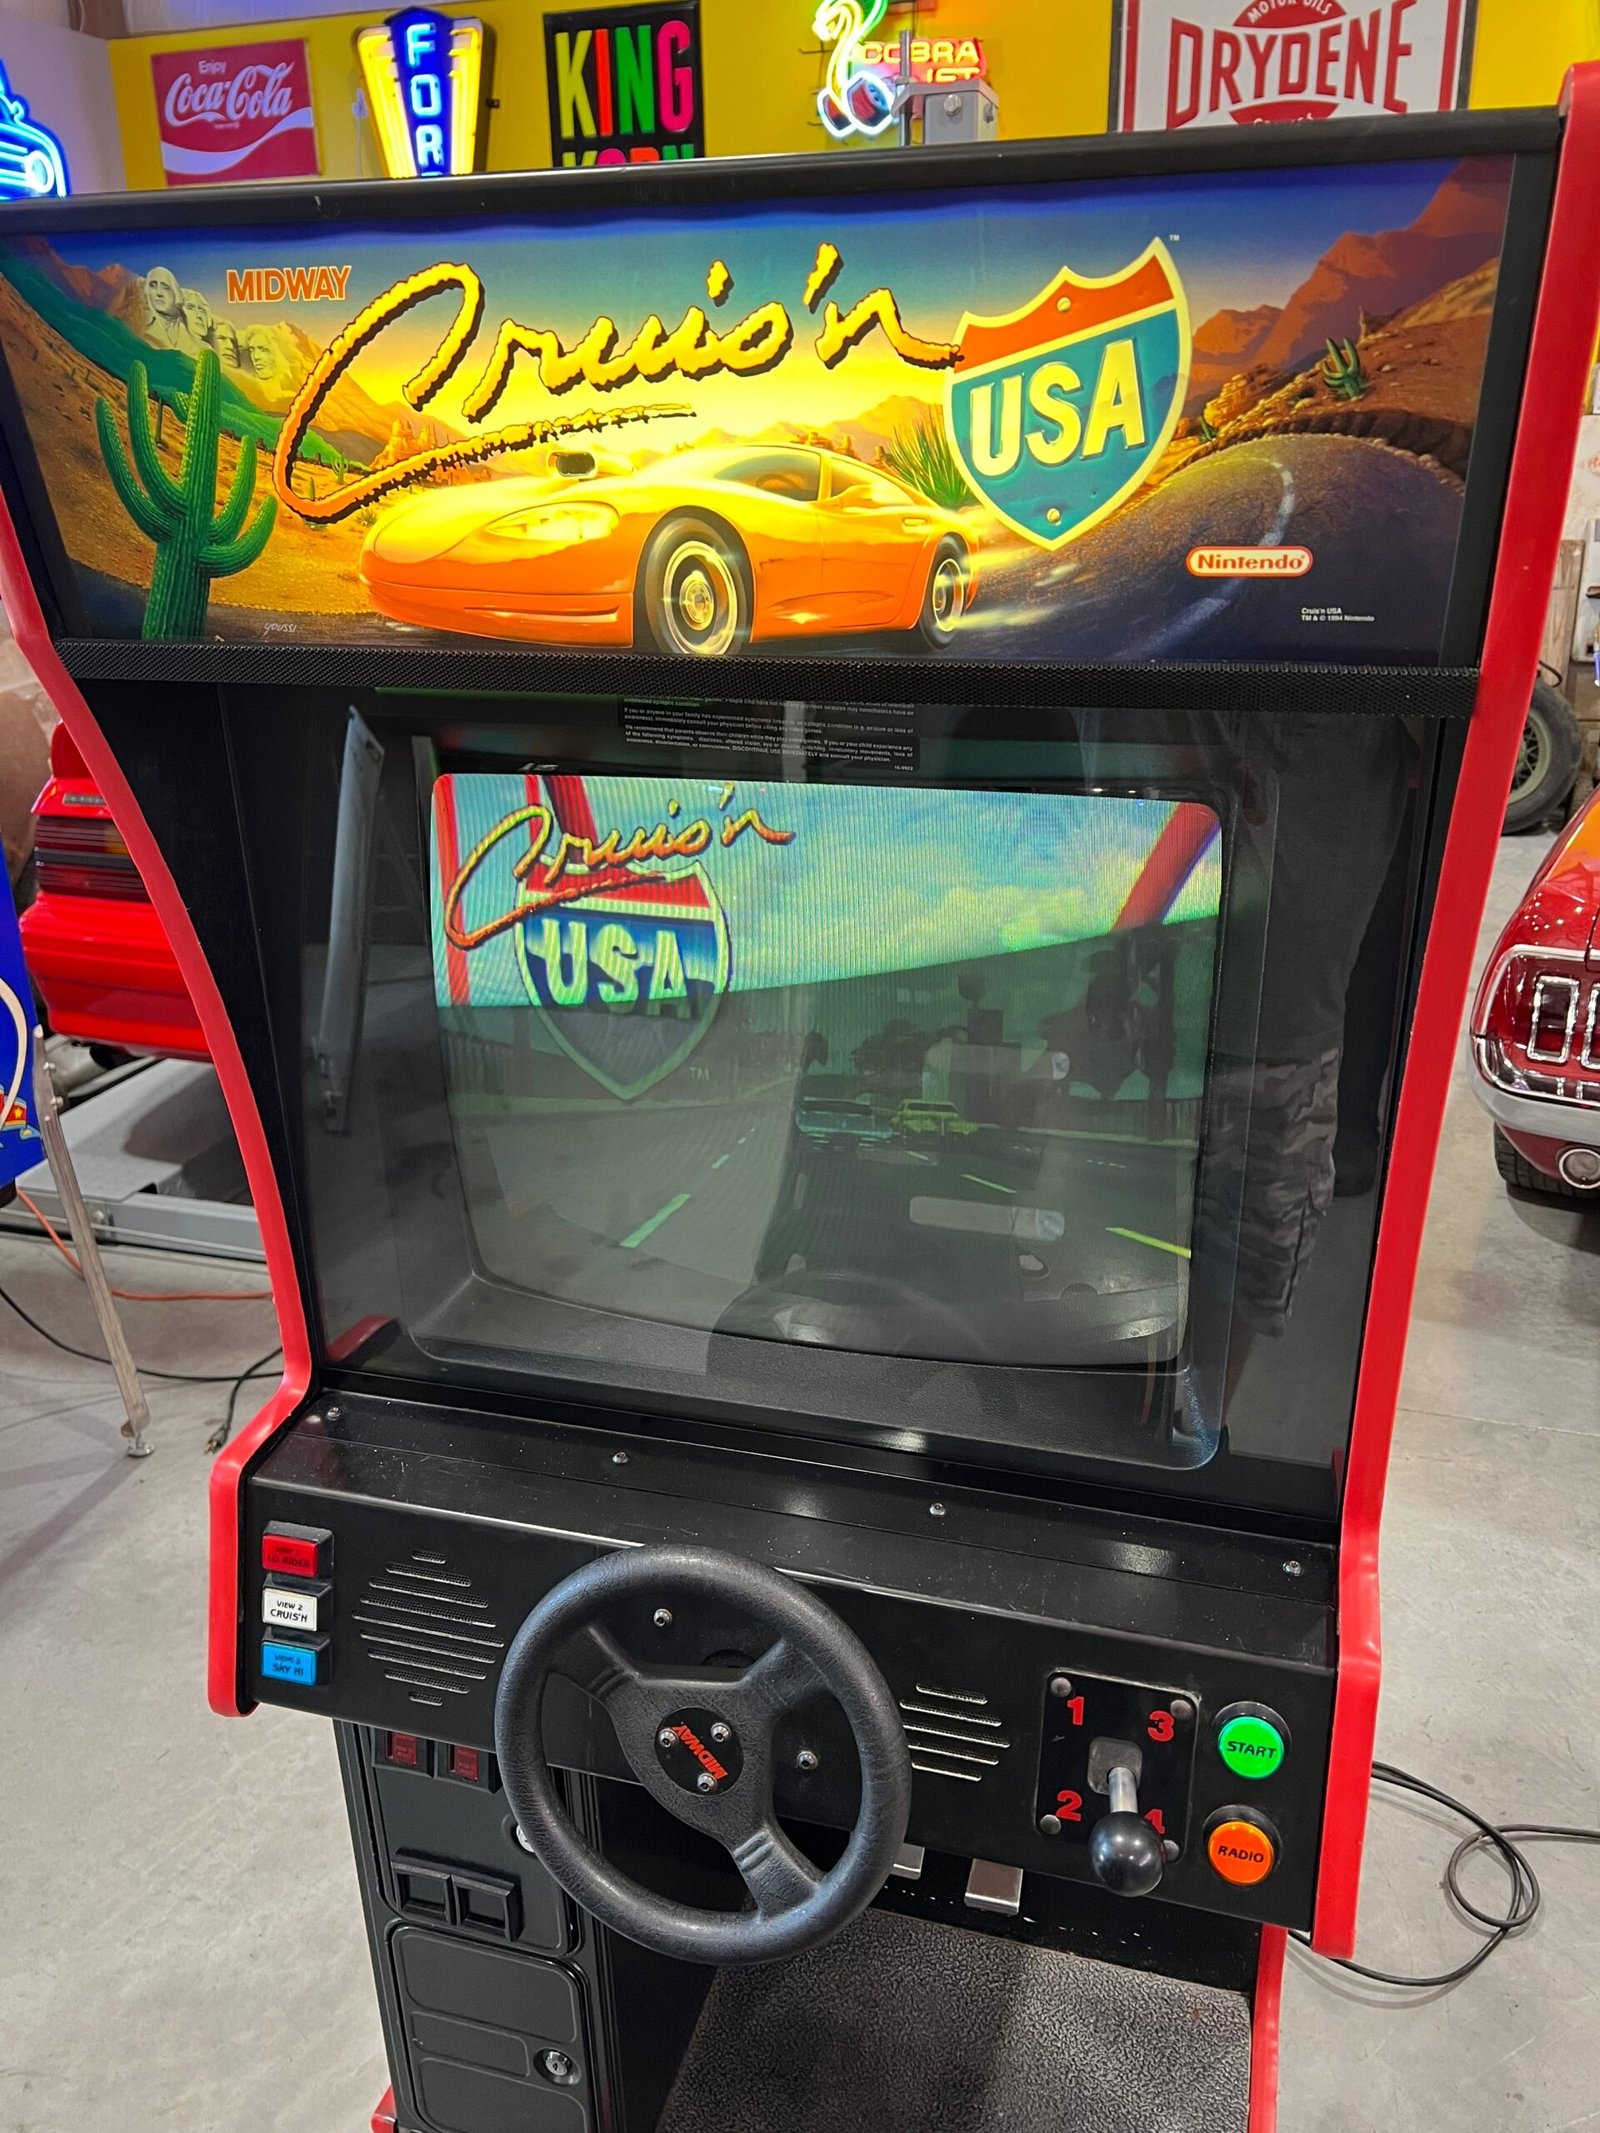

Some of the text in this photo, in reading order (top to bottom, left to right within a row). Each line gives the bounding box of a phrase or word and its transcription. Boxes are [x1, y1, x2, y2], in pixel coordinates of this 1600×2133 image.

[198, 60, 227, 74] Enjoy
[862, 41, 980, 65] COBRA
[1166, 0, 1417, 130] DRYDENE
[165, 61, 295, 127] Coca-Cola
[555, 20, 694, 139] KING
[406, 23, 445, 177] FOR
[226, 265, 352, 303] MIDWAY
[272, 243, 965, 524] Cruis'n
[970, 338, 1146, 478] USA
[542, 918, 692, 1020] USA
[270, 1609, 308, 1622] CRUIS'N
[276, 1600, 296, 1610] VIEW
[1066, 1696, 1085, 1726] 1
[1147, 1710, 1175, 1742] 3
[671, 1721, 729, 1780] MIDWAY
[1226, 1741, 1278, 1759] START
[1055, 1789, 1083, 1822] 2
[1217, 1845, 1265, 1864] RADIO
